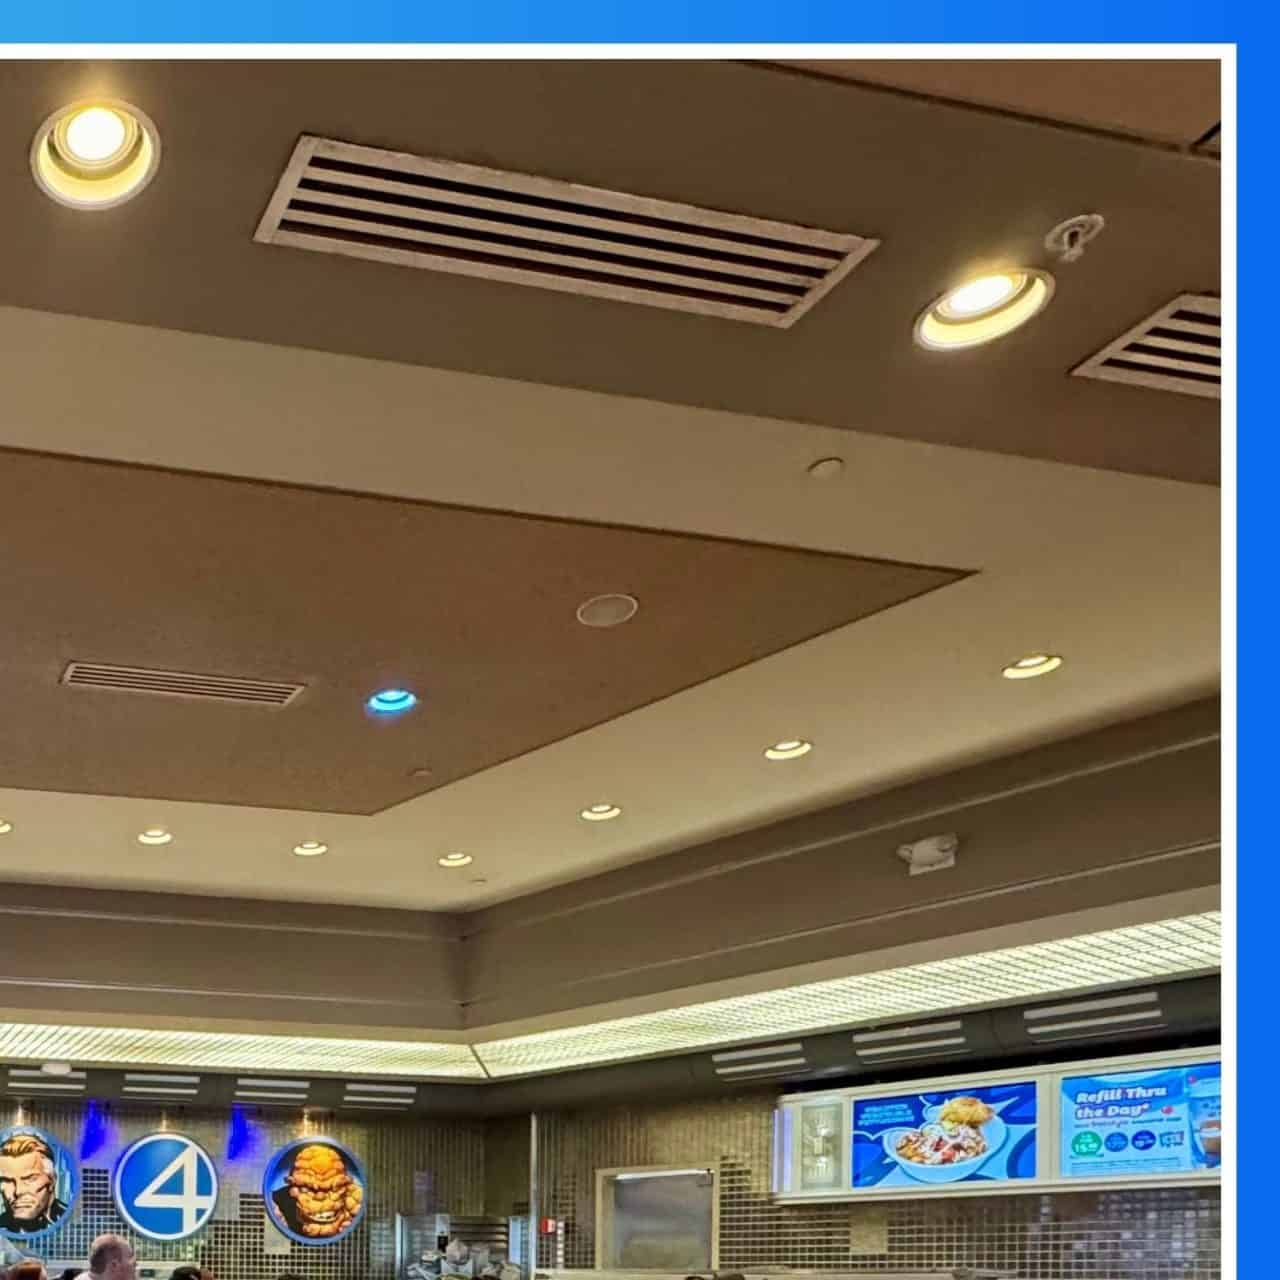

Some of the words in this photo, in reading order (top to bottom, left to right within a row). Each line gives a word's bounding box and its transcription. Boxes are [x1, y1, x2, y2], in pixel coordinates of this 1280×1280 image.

[1076, 1088, 1122, 1104] Refill
[1126, 1086, 1167, 1098] Thru
[1076, 1106, 1104, 1118] the
[133, 1145, 214, 1235] 4
